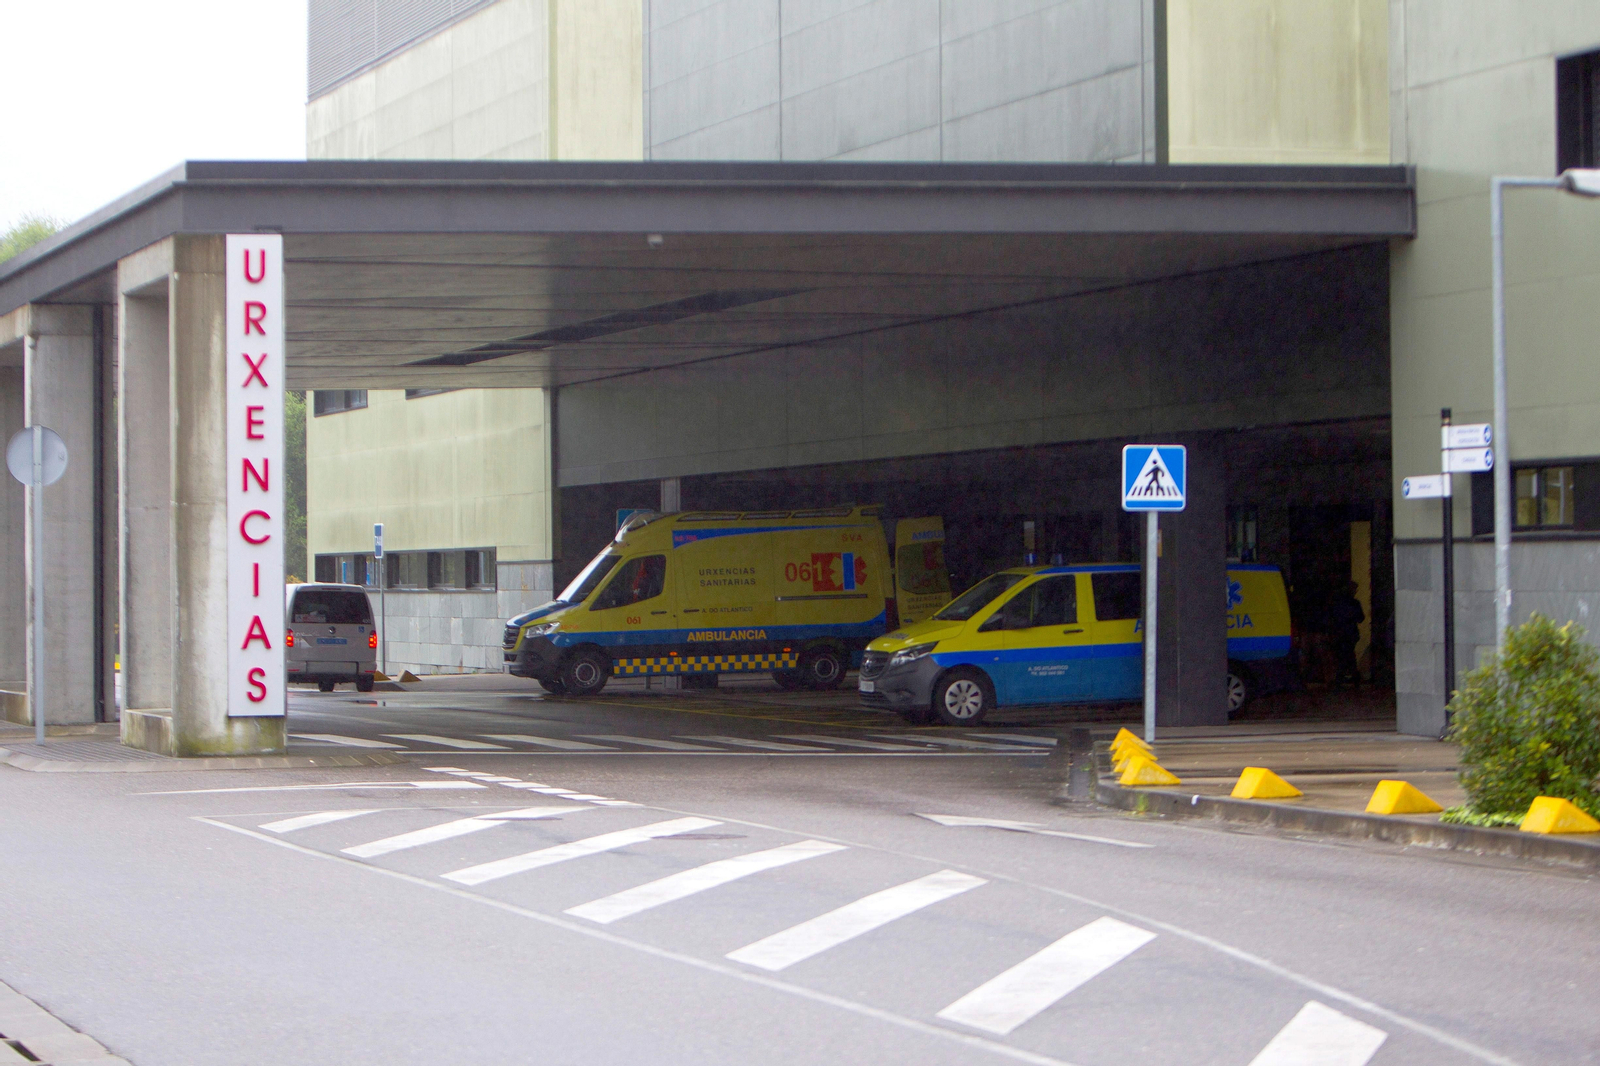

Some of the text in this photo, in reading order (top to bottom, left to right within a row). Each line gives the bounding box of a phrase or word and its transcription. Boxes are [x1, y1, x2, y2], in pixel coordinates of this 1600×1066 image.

[240, 249, 272, 704] URXENCIAS
[841, 533, 863, 542] SVA
[698, 567, 756, 576] URXENCIAS
[784, 561, 823, 582] 061
[699, 578, 756, 587] SANITARIAS
[626, 616, 642, 625] 061
[686, 629, 767, 642] AMBULANCIA
